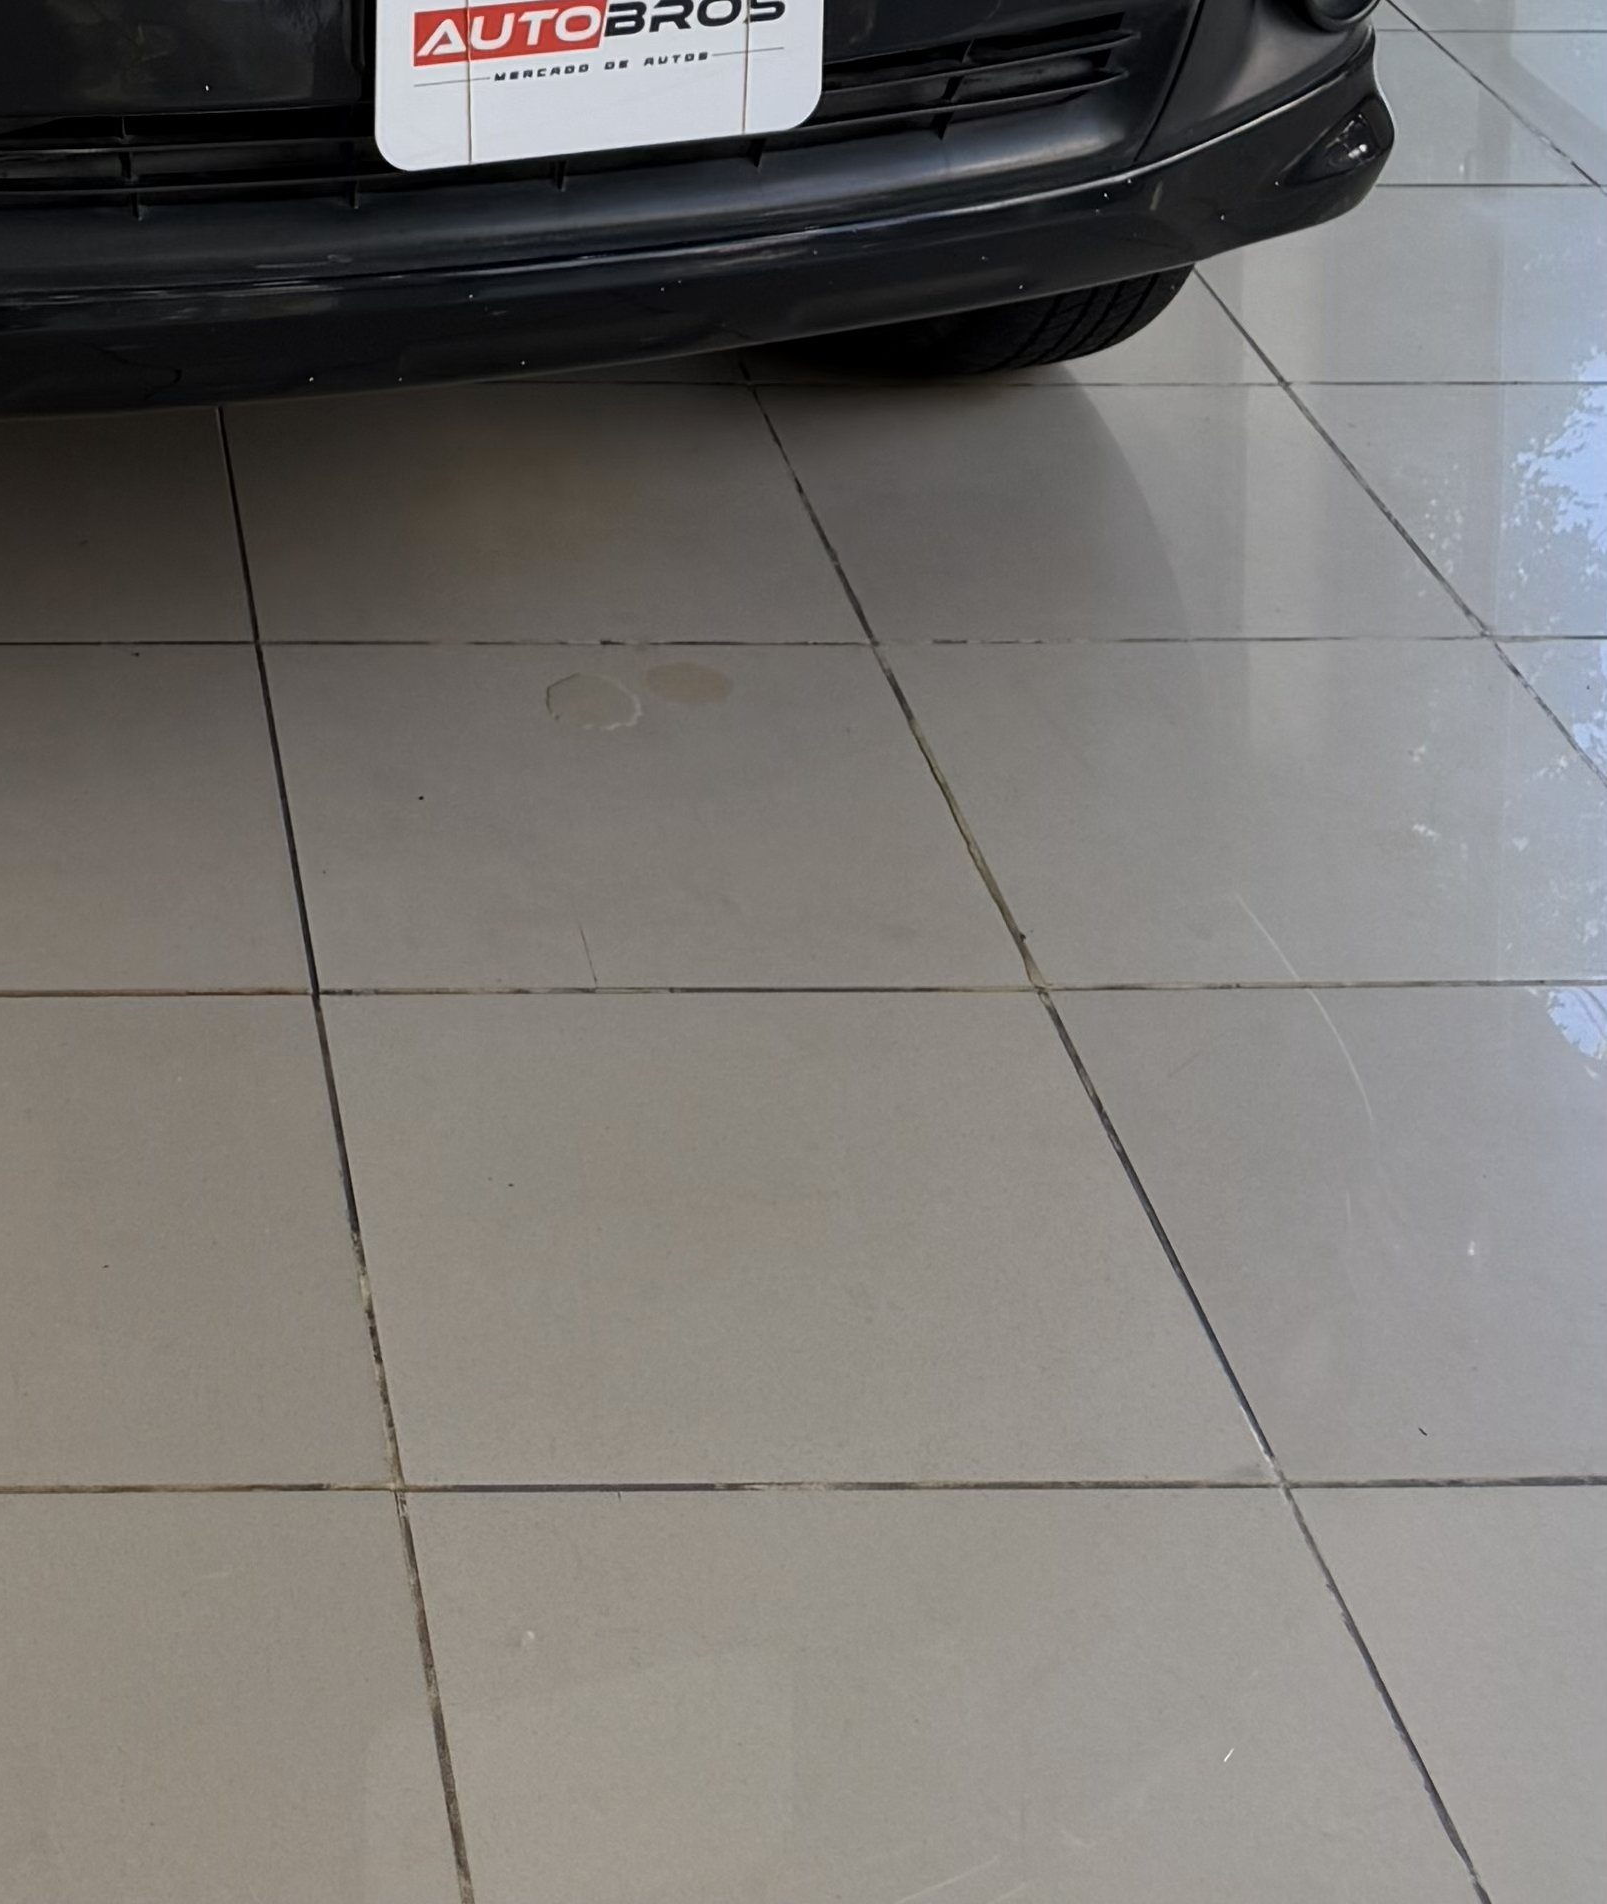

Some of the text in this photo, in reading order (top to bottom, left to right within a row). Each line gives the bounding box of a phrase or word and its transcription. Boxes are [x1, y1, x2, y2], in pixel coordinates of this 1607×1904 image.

[493, 51, 709, 82] MERCADO DE AUTOS
